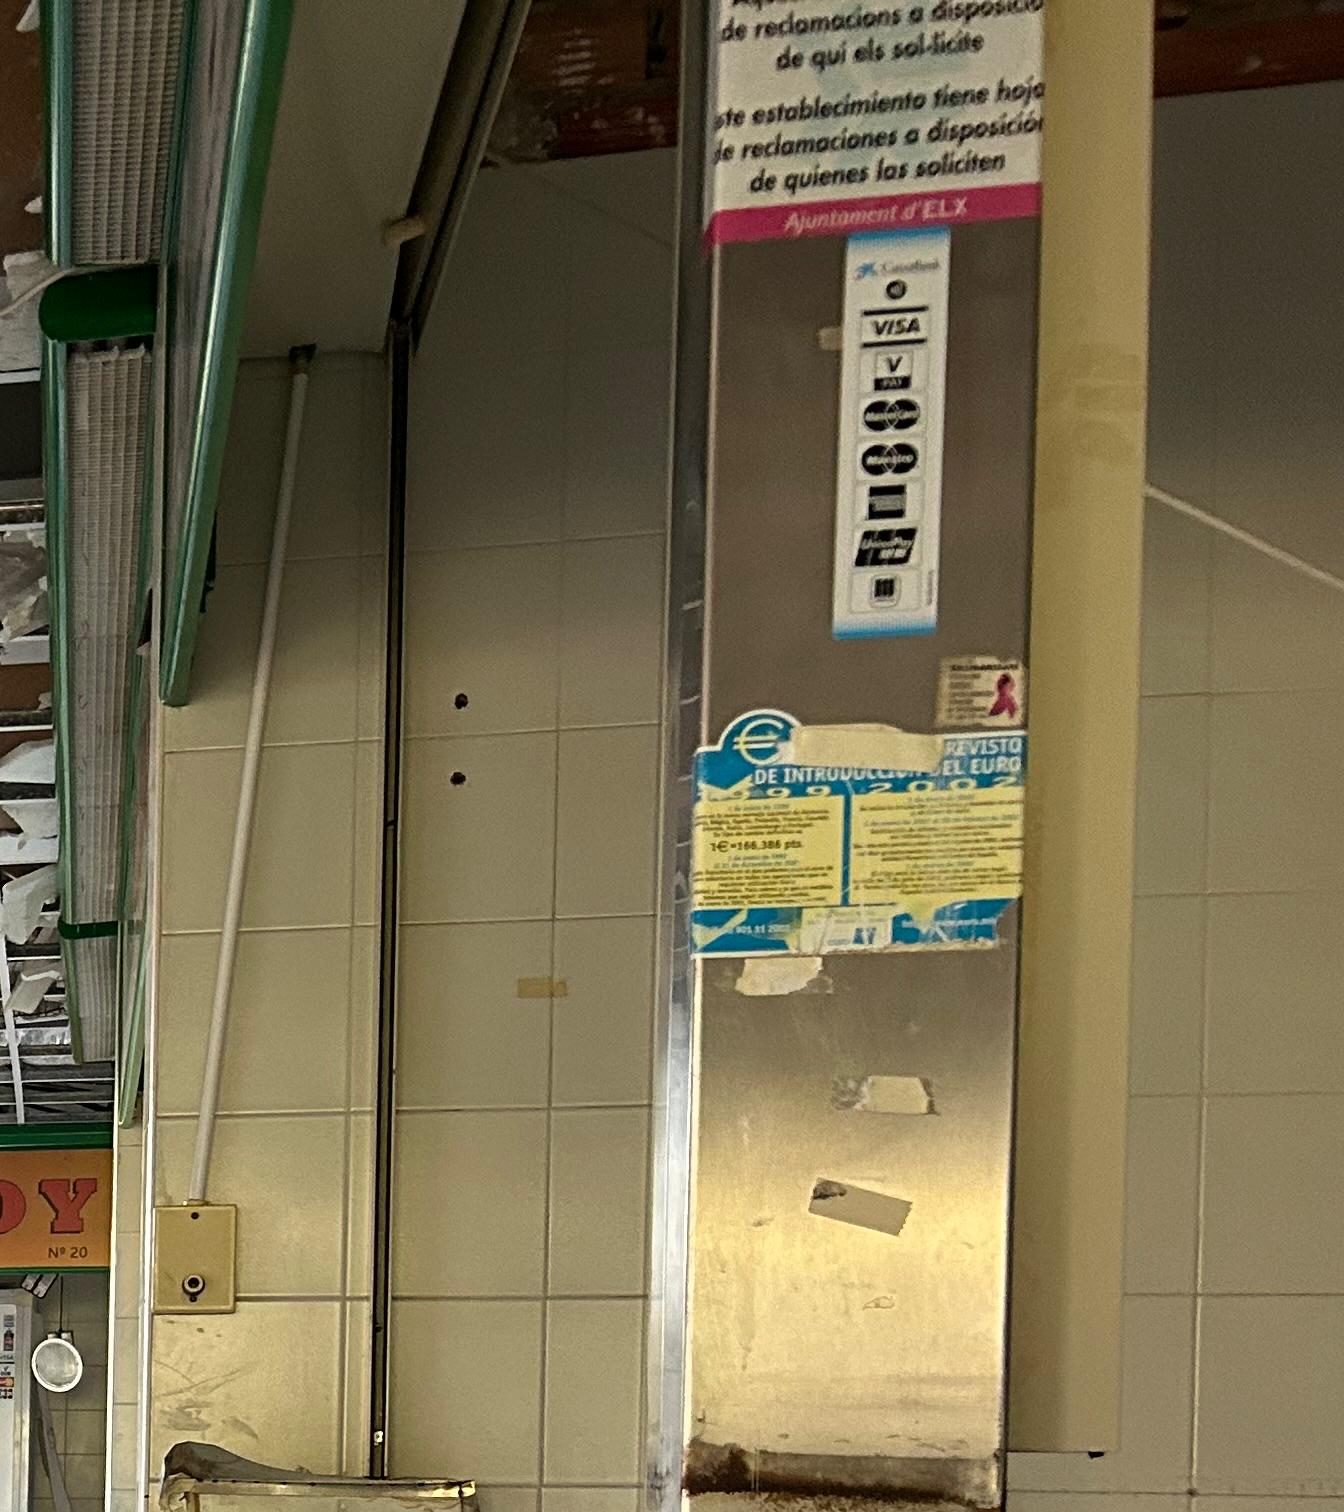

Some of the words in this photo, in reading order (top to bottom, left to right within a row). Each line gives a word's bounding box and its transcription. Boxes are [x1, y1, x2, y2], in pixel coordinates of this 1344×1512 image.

[721, 16, 747, 41] de
[776, 45, 803, 70] de
[811, 39, 847, 72] qui
[854, 35, 885, 62] els
[752, 89, 927, 125] establecimiento
[933, 82, 989, 108] tiene
[741, 127, 898, 161] reclamaciones
[904, 127, 919, 145] a
[749, 168, 777, 193] de
[784, 163, 869, 195] quienes
[875, 157, 909, 182] las
[915, 150, 1006, 178] soliciten
[783, 205, 898, 237] Ajuntament
[872, 317, 920, 335] VISA
[946, 736, 1022, 755] REVISTO
[755, 767, 779, 785] DE
[970, 756, 1022, 775] EURO
[38, 1178, 98, 1235] Y
[70, 1246, 88, 1259] 20
